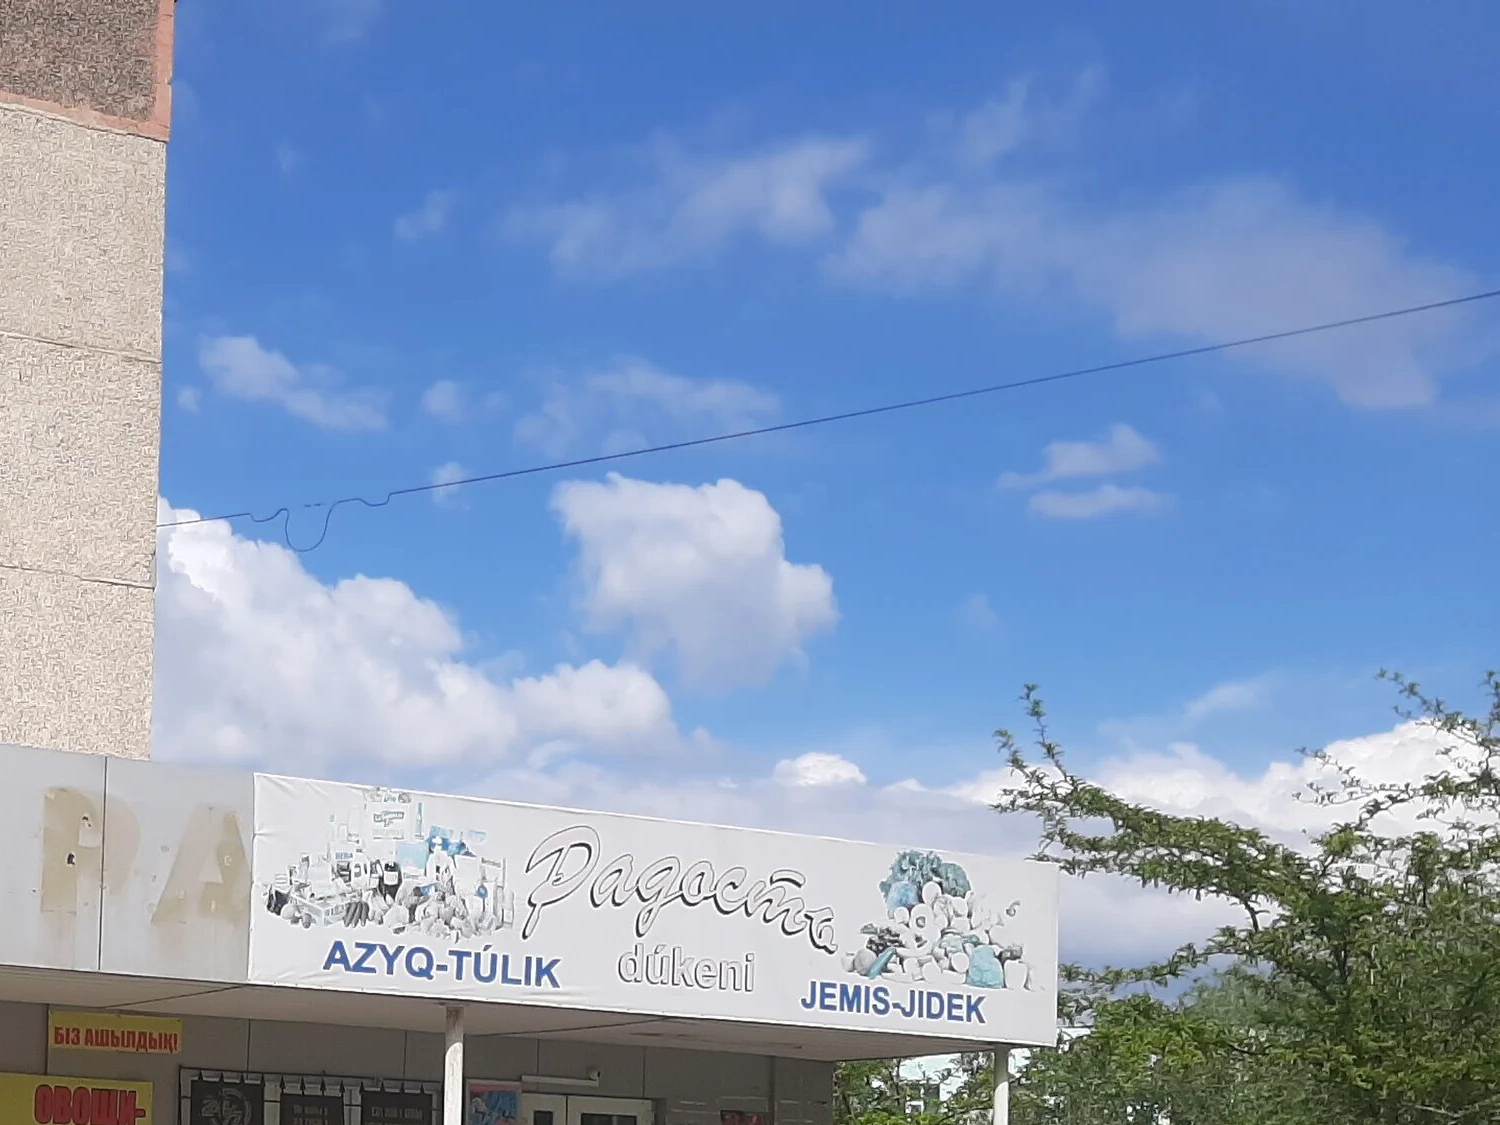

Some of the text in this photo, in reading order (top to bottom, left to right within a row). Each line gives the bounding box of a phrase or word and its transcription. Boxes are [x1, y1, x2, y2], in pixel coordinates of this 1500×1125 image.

[322, 940, 561, 989] AZYQ-TÚLIK
[618, 943, 755, 993] dúkeni
[801, 980, 988, 1025] JEMIS-JIDEK
